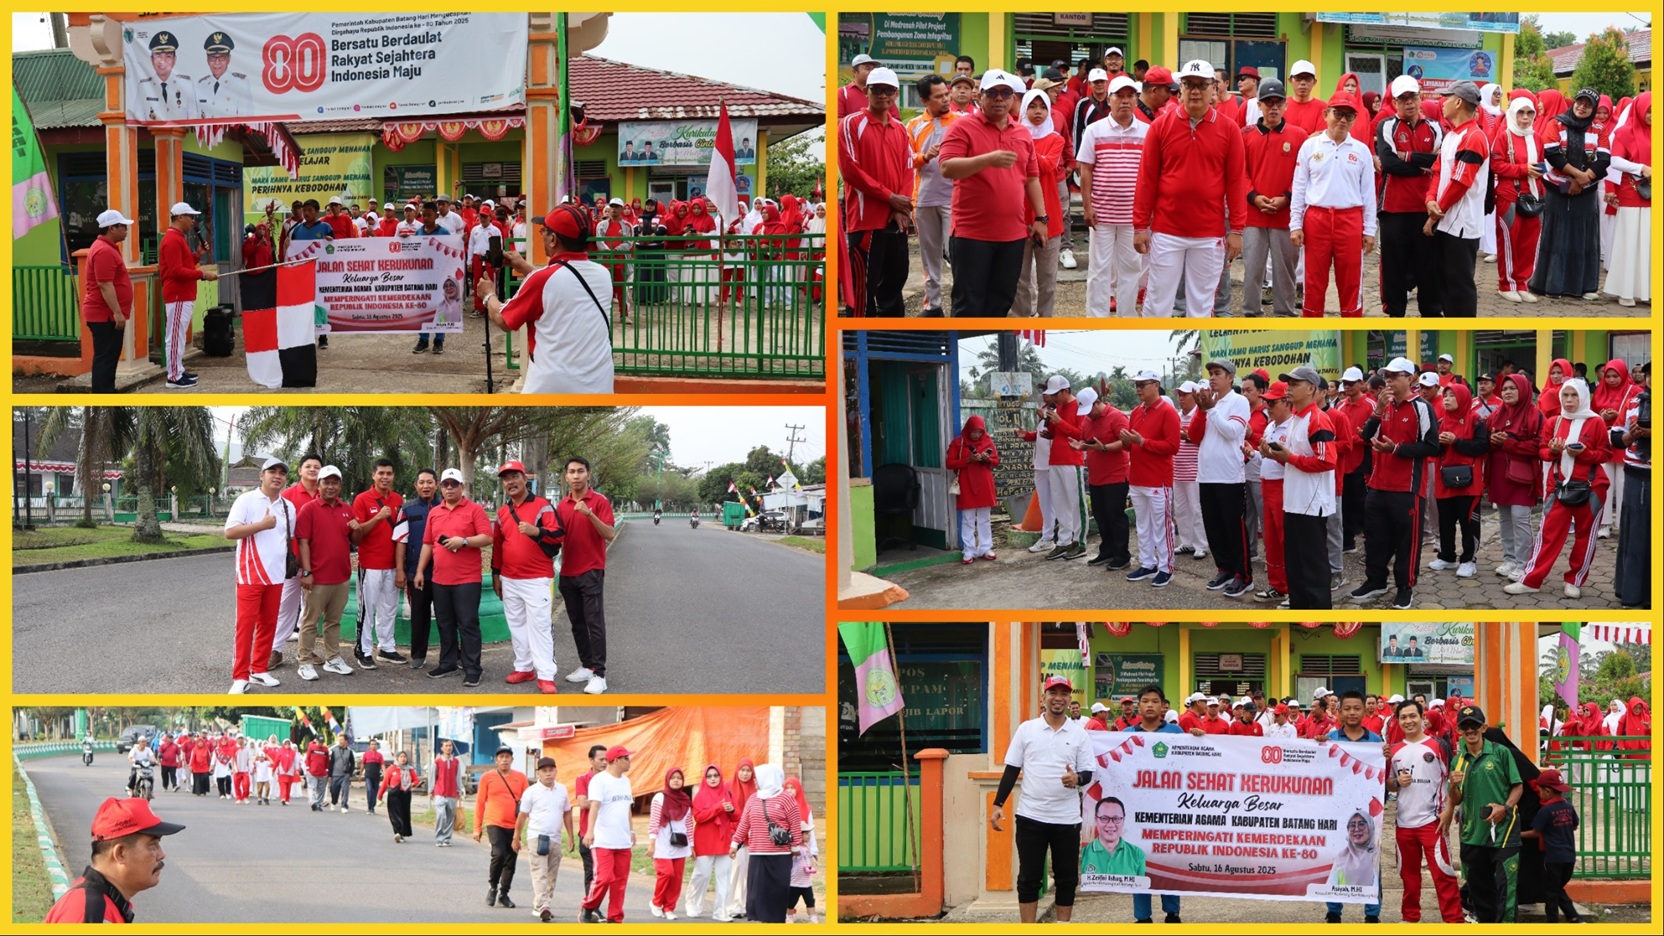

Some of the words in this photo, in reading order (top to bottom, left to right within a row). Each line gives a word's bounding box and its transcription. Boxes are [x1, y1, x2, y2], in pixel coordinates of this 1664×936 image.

[331, 28, 360, 37] Dirgahayu
[360, 25, 384, 34] Republik
[385, 23, 413, 32] Indonesia
[434, 19, 453, 27] Tahun
[453, 17, 469, 25] 2025
[332, 20, 364, 28] Pemerintah
[364, 17, 395, 26] Kabupaten
[396, 14, 416, 23] Batang
[890, 20, 915, 29] Madrasah
[915, 21, 928, 30] Pilot
[928, 21, 946, 32] Project
[331, 37, 379, 52] Bersatu
[381, 31, 442, 48] Berdaulat
[877, 30, 914, 40] Pembangunan
[914, 31, 927, 40] Zona
[927, 31, 953, 42] Integritas
[262, 32, 326, 95] 80
[331, 52, 373, 69] Rakyat
[375, 49, 436, 66] Sejahtera
[331, 65, 390, 82] Indonesia
[393, 64, 422, 80] Maju
[670, 125, 716, 141] Kurikulu
[307, 146, 337, 155] SANGGUP
[659, 140, 693, 149] Berbasis
[300, 156, 330, 166] ELAJAR
[270, 176, 289, 184] KAMU
[312, 174, 342, 183] SANGGUP
[251, 184, 293, 195] PERIHNYA
[294, 182, 348, 194] KEBODOHAN
[317, 261, 345, 273] JALAN
[346, 259, 376, 272] SEHAT
[377, 258, 434, 271] KERUKUNAN
[342, 273, 379, 285] Keluarga
[380, 271, 405, 283] Besar
[323, 294, 377, 303] MEMPERINGATI
[377, 293, 432, 302] KEMERDEKAAN
[330, 302, 363, 311] REPUBLIK
[364, 302, 404, 310] INDONESIA
[1228, 347, 1247, 356] KAMU
[1248, 344, 1271, 355] HARUS
[1271, 341, 1304, 352] SANGGUP
[1253, 352, 1311, 368] KEBODOHAN
[1424, 635, 1460, 645] Berbasis
[898, 668, 925, 678] POS
[911, 684, 943, 695] PAM
[926, 706, 965, 716] LAPOR
[1261, 745, 1283, 764] 80
[1133, 770, 1183, 790] JALAN
[1187, 772, 1236, 792] SEHAT
[1241, 774, 1333, 796] KERUKUNAN
[1177, 792, 1240, 814] Keluarga
[1243, 794, 1284, 812] Besar
[1135, 811, 1193, 825] KEMENTERIAN
[1195, 814, 1227, 826] AGAMA
[1231, 815, 1280, 828] KABUPATEN
[1282, 817, 1316, 830] BATANG
[1317, 819, 1338, 831] HARI
[1141, 829, 1234, 843] MEMPERINGATI
[1236, 833, 1327, 847] KEMERDEKAAN
[1152, 842, 1209, 856] REPUBLIK
[1212, 845, 1279, 858] INDONESIA
[1282, 848, 1318, 860] KE-80
[1188, 862, 1211, 873] Sabtu,
[1213, 863, 1223, 873] 16
[1224, 864, 1256, 875] Agustus
[1257, 865, 1276, 875] 2025
